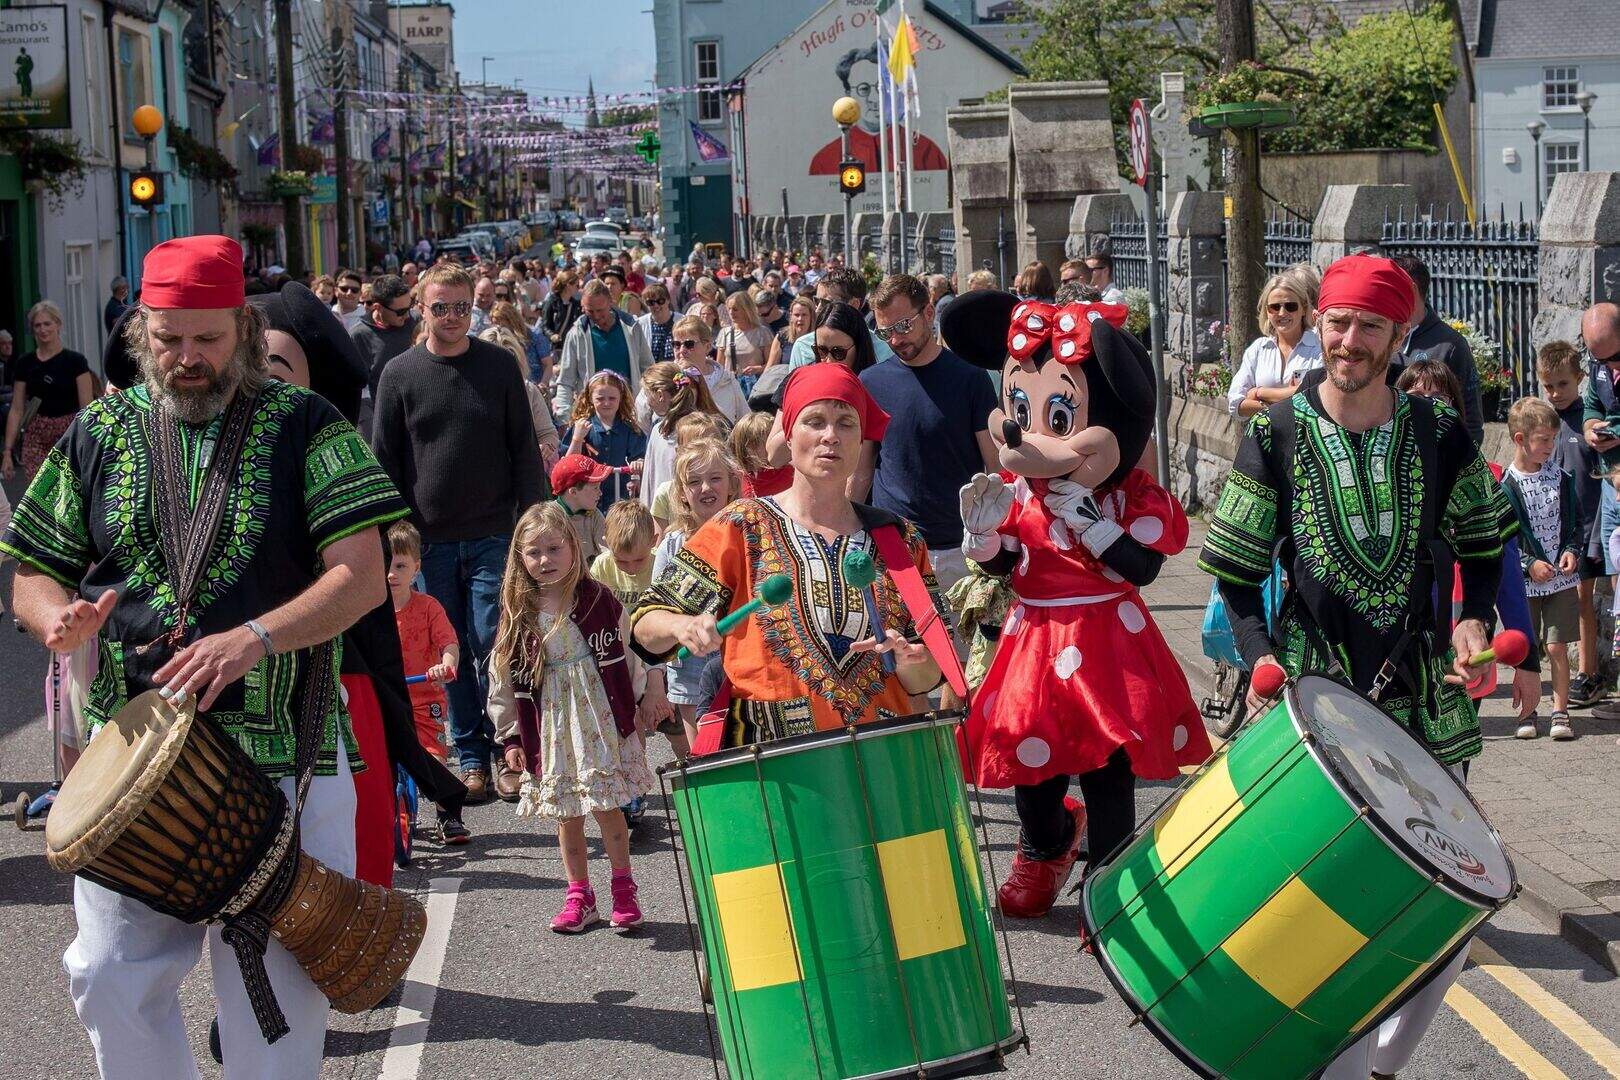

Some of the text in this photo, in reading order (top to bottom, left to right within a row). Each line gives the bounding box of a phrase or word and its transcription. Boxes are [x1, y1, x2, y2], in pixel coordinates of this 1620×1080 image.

[0, 36, 50, 45] estaurant
[406, 26, 444, 38] HARP
[800, 15, 846, 57] Hugh
[587, 627, 623, 661] Yor
[1424, 831, 1473, 864] RMV
